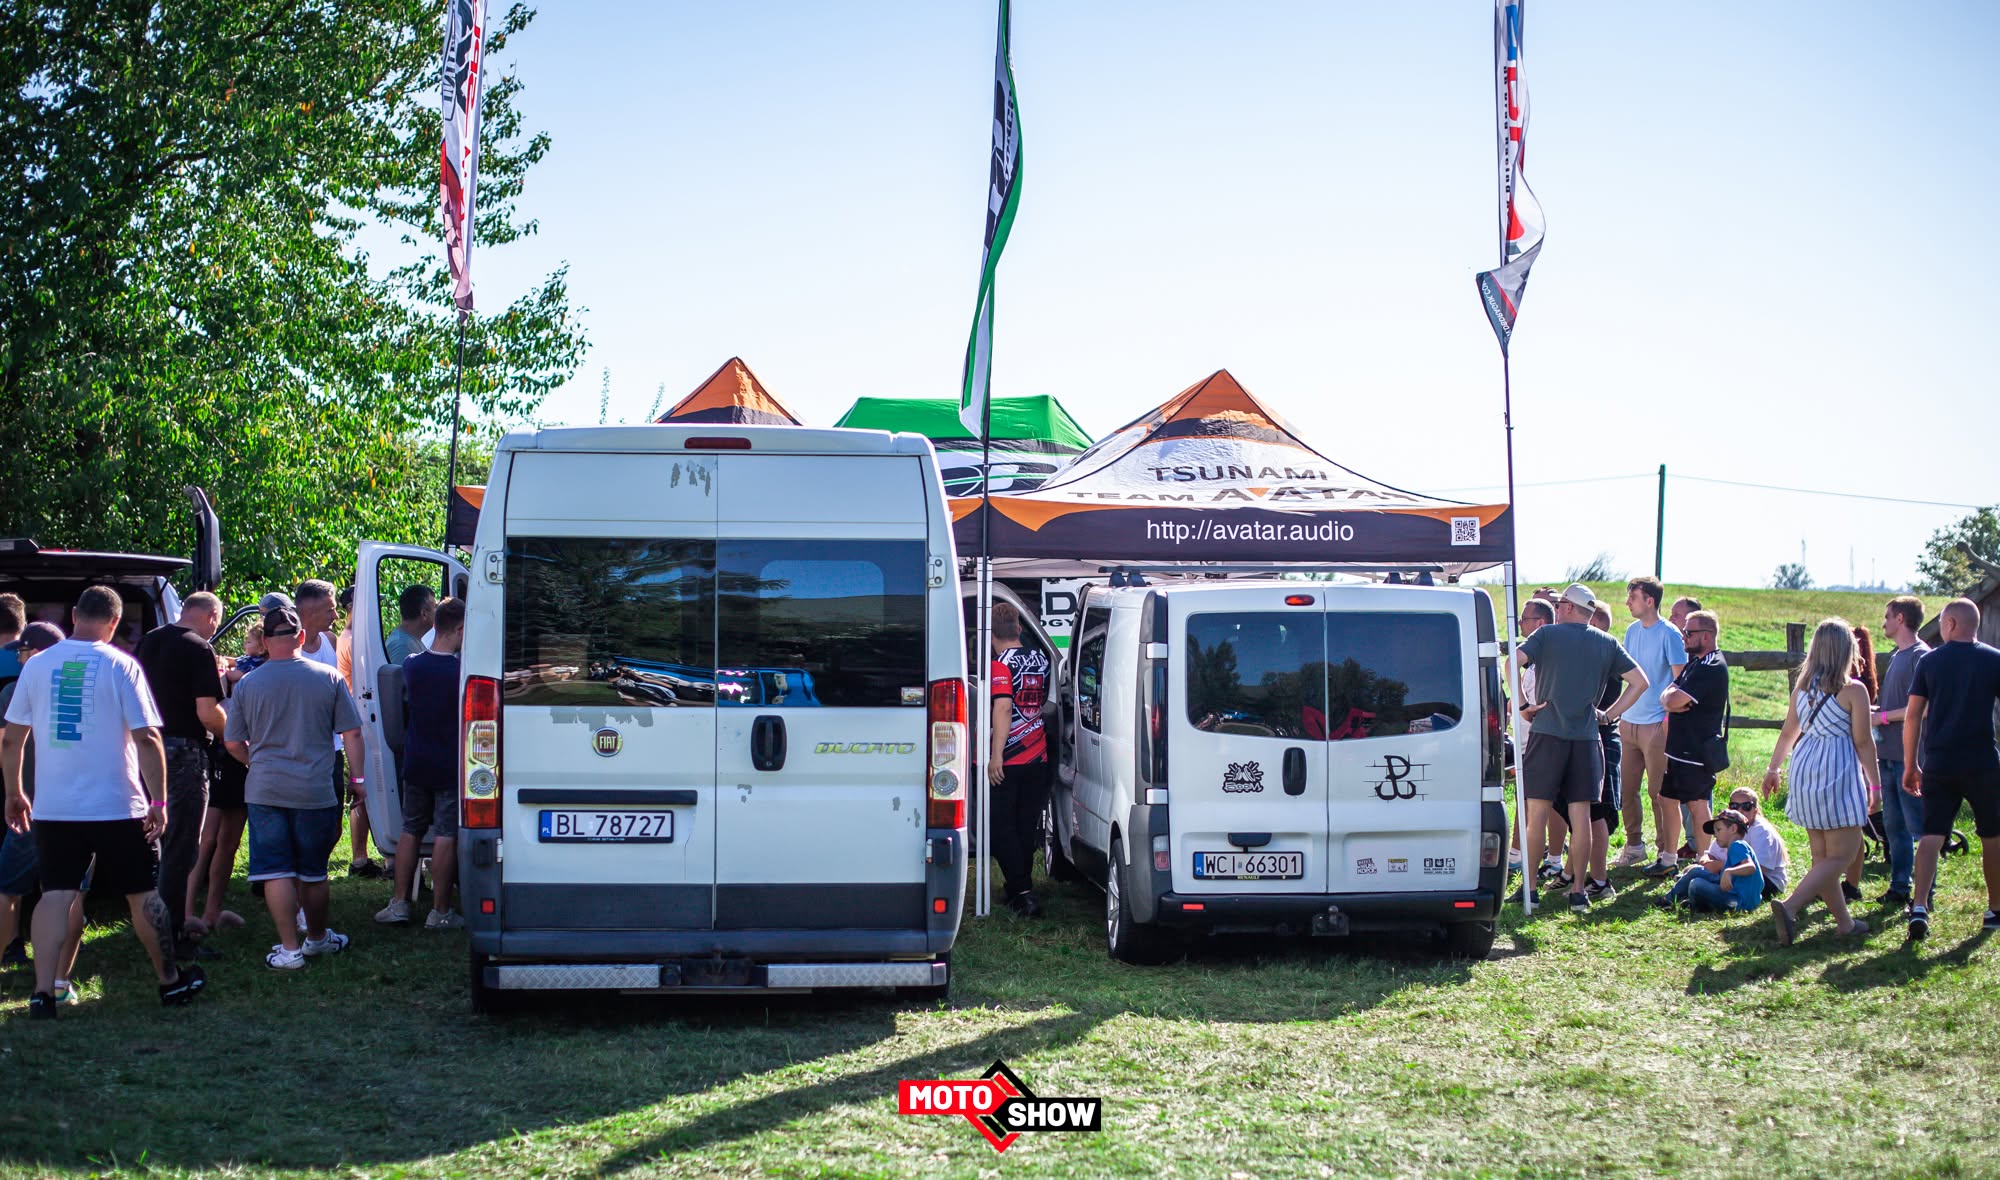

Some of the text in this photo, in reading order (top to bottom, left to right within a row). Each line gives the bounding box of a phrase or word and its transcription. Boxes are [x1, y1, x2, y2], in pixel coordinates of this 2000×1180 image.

[1147, 465, 1328, 482] TSUNAMI
[1067, 491, 1195, 502] TEAM
[1146, 519, 1354, 545] http://avatar.audio
[56, 661, 88, 741] PUMA
[599, 735, 617, 750] FIAT
[814, 741, 917, 755] DUCATO
[556, 814, 585, 836] BL
[595, 814, 666, 836] 78727
[1205, 855, 1235, 873] WCI
[1245, 855, 1297, 873] 66301
